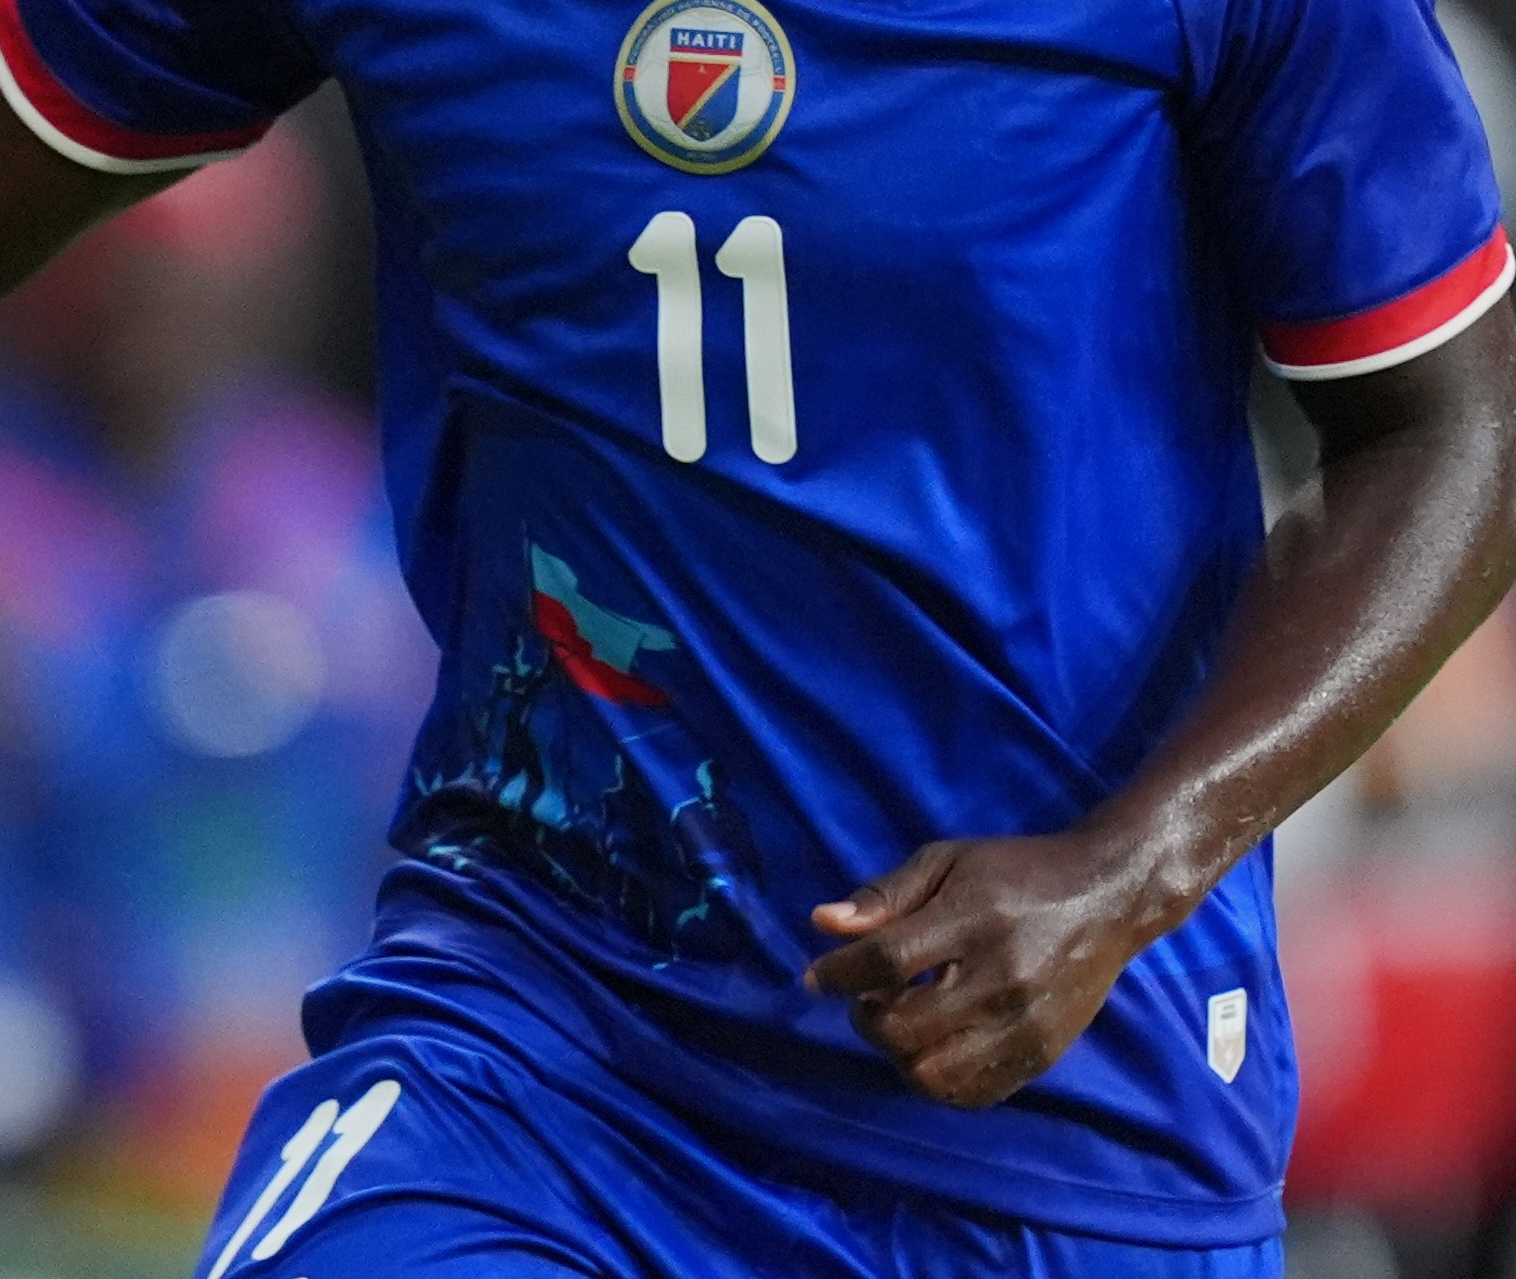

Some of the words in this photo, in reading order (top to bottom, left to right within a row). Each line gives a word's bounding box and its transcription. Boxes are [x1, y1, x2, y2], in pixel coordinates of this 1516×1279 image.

[677, 31, 736, 50] HAITI
[628, 211, 797, 464] 11
[206, 1079, 402, 1279] 11
